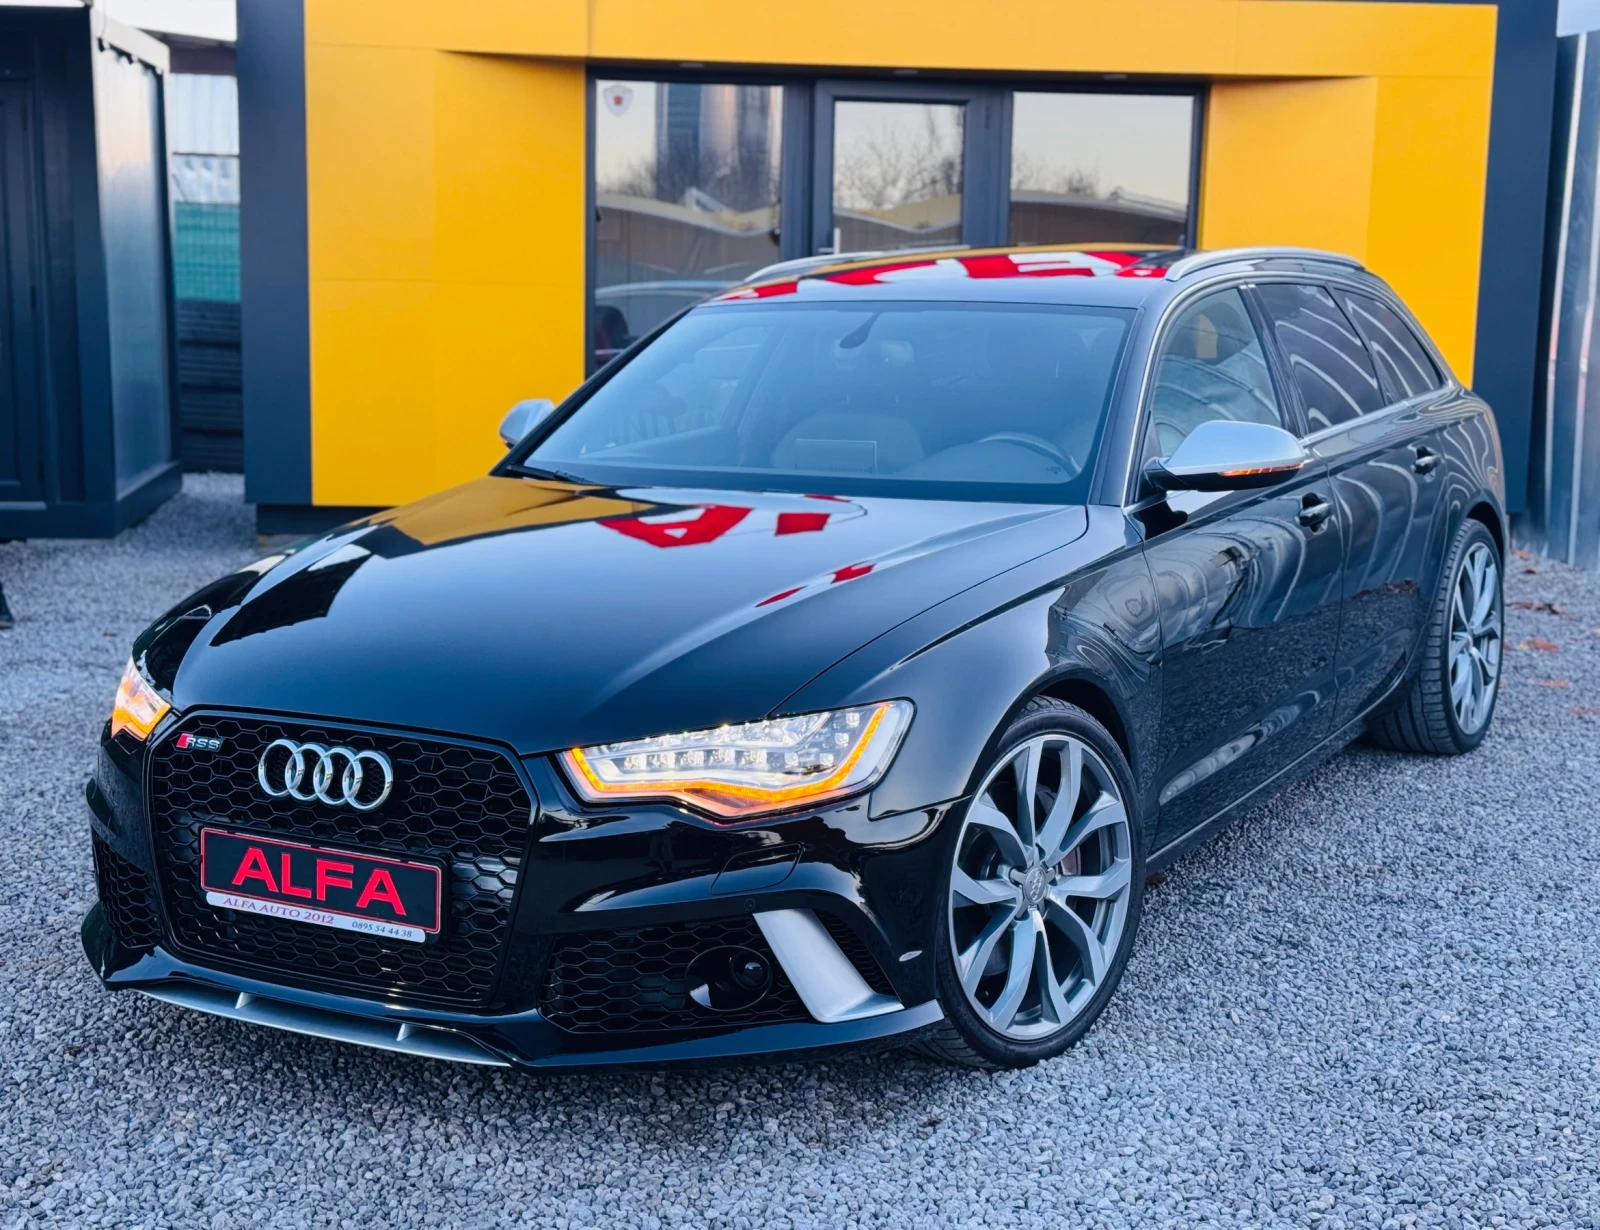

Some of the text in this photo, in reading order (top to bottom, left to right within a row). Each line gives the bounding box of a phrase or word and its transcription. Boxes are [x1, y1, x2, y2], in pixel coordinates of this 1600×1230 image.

[232, 847, 407, 916] ALFA
[223, 898, 413, 938] ALFA AUTO 2012 0895 54 44 38
